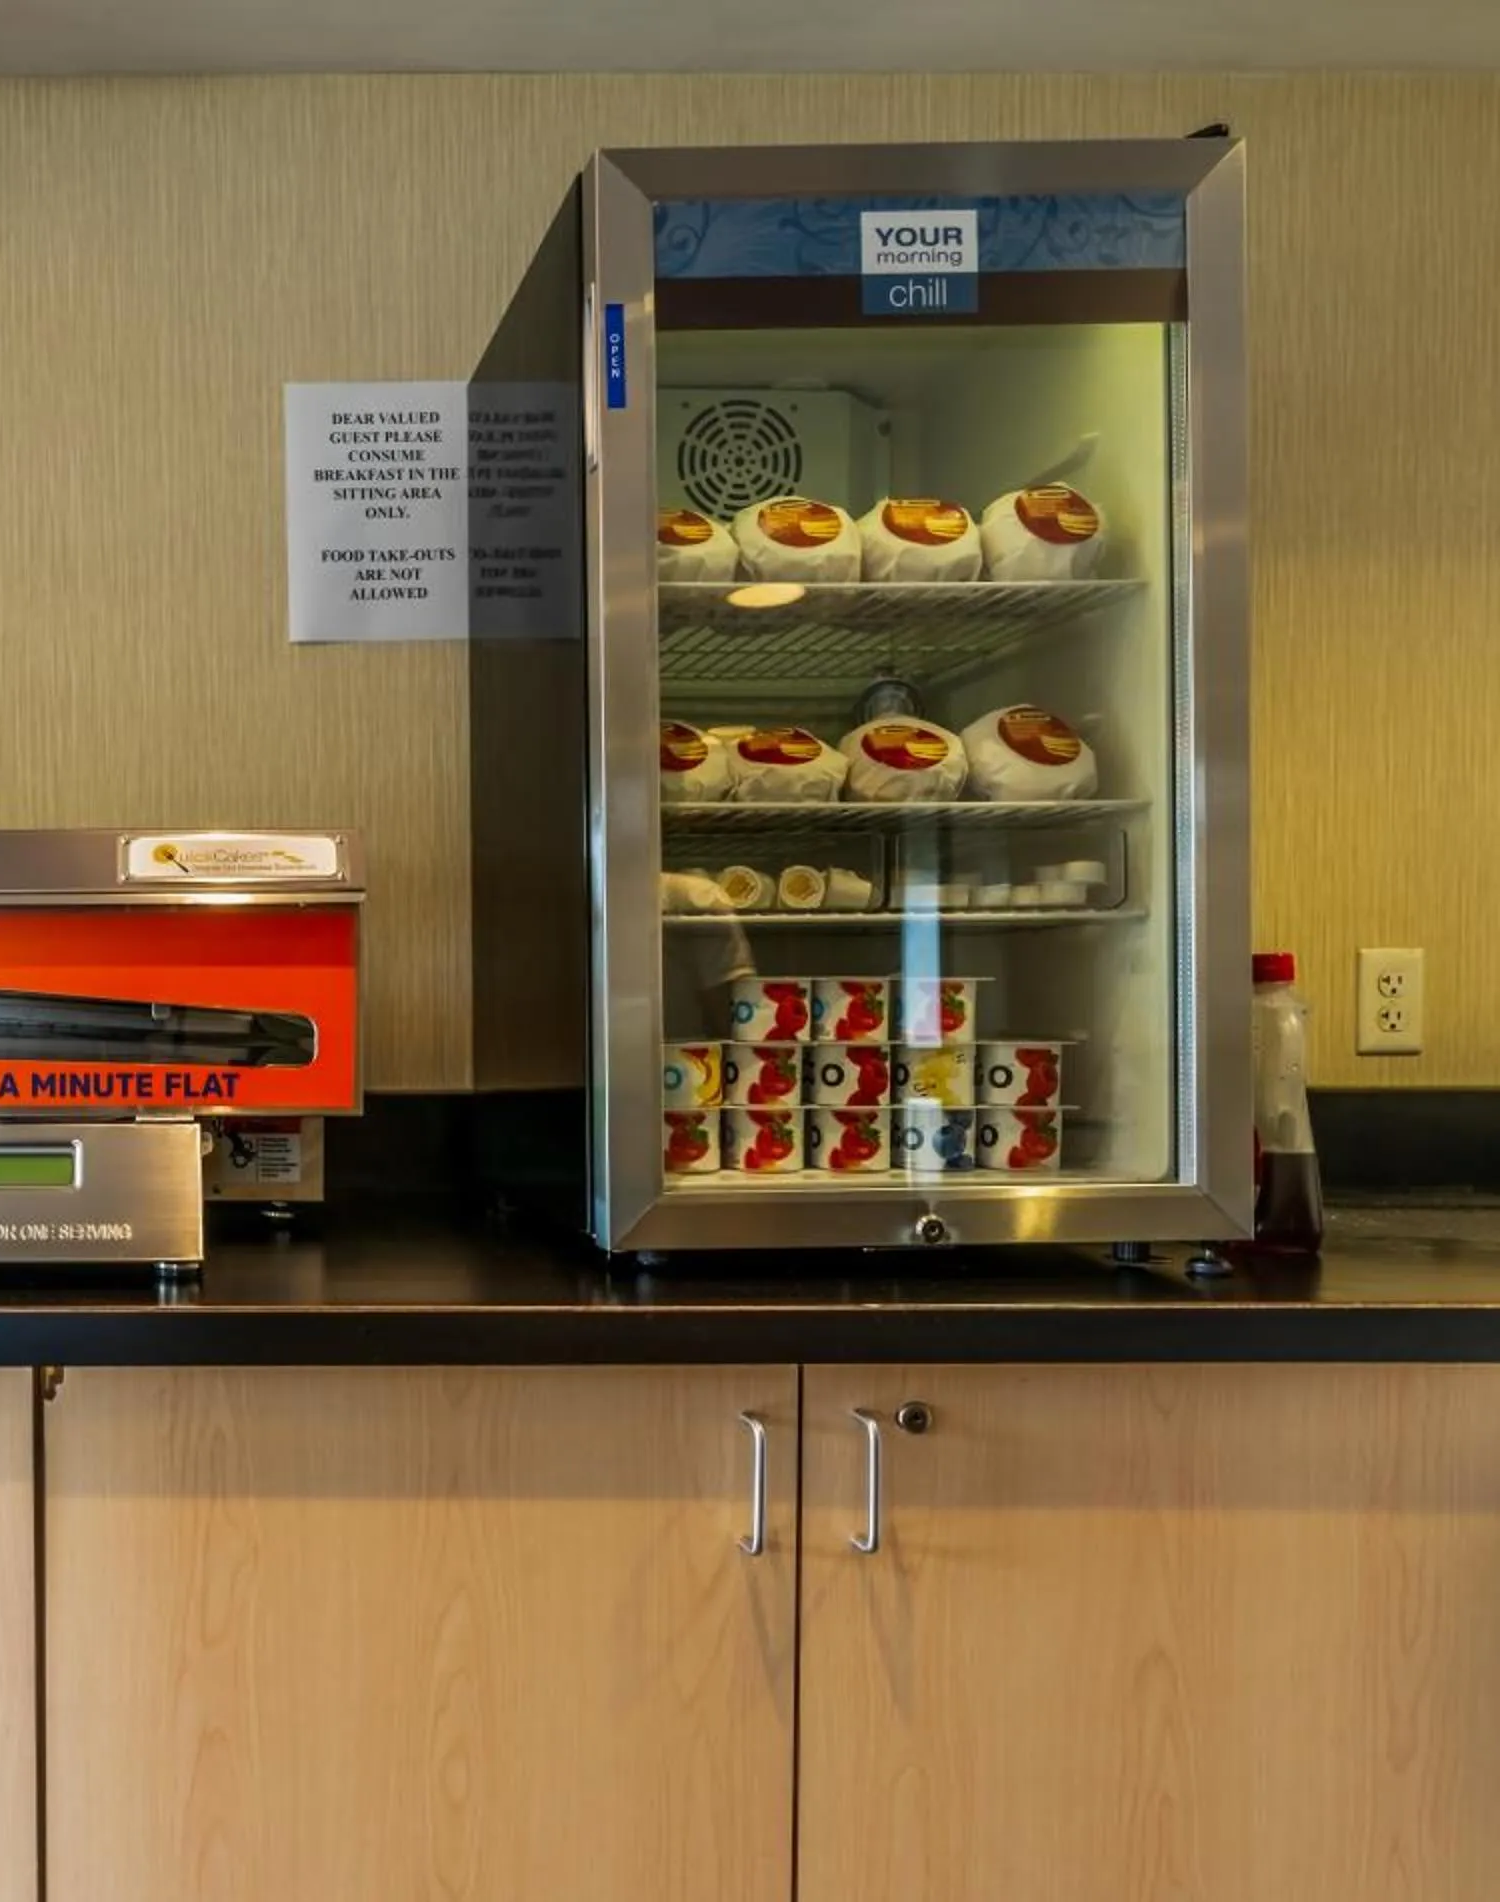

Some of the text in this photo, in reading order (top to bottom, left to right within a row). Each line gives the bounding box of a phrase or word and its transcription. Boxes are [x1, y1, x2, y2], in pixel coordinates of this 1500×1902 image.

[875, 227, 963, 247] YOUR
[877, 248, 963, 267] morning
[889, 278, 947, 307] chill
[610, 333, 621, 379] OPEN
[331, 410, 440, 425] DEAR VALUED
[329, 429, 442, 444] GUEST PLEASE
[347, 449, 426, 462] CONSUME
[314, 468, 403, 482] BREAKFAST
[408, 468, 426, 481] IN
[428, 467, 461, 480] THE
[333, 487, 442, 501] SITTING AREA
[365, 506, 410, 520] ONLY.
[321, 549, 364, 563] FOOD
[369, 549, 456, 563] TAKE-OUTS
[355, 567, 423, 581] ARE NOT
[350, 587, 428, 601] ALLOWED
[31, 1073, 153, 1097] MINUTE
[165, 1073, 239, 1097] FLAT
[58, 1223, 133, 1241] SERVING
